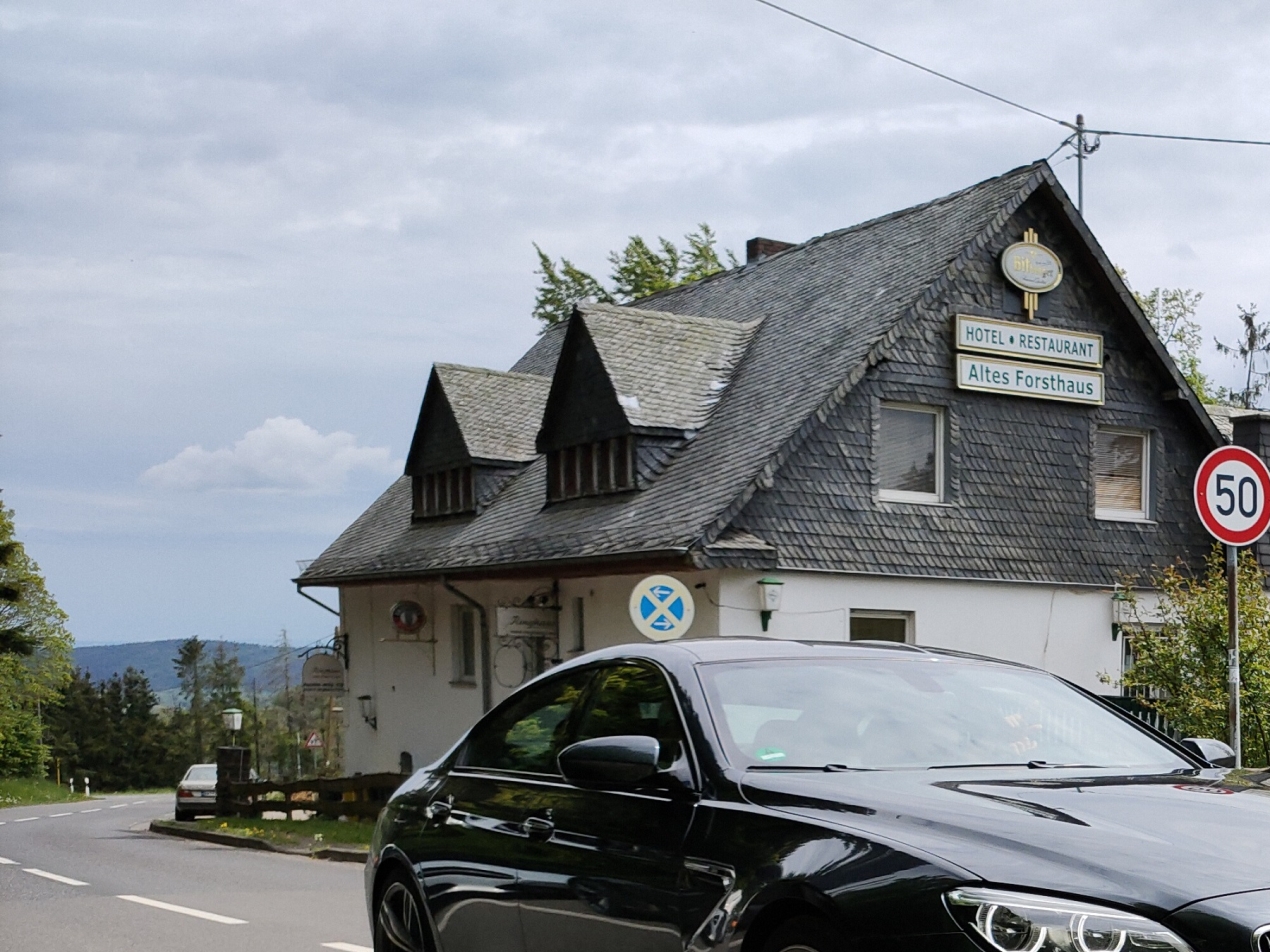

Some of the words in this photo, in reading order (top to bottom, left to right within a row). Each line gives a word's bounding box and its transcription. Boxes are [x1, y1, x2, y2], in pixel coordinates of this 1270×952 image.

[966, 326, 1005, 345] HOTEL
[1019, 333, 1094, 357] RESTAURANT
[968, 363, 1010, 385] Altes
[1016, 369, 1094, 395] Forsthaus
[1215, 473, 1258, 518] 50
